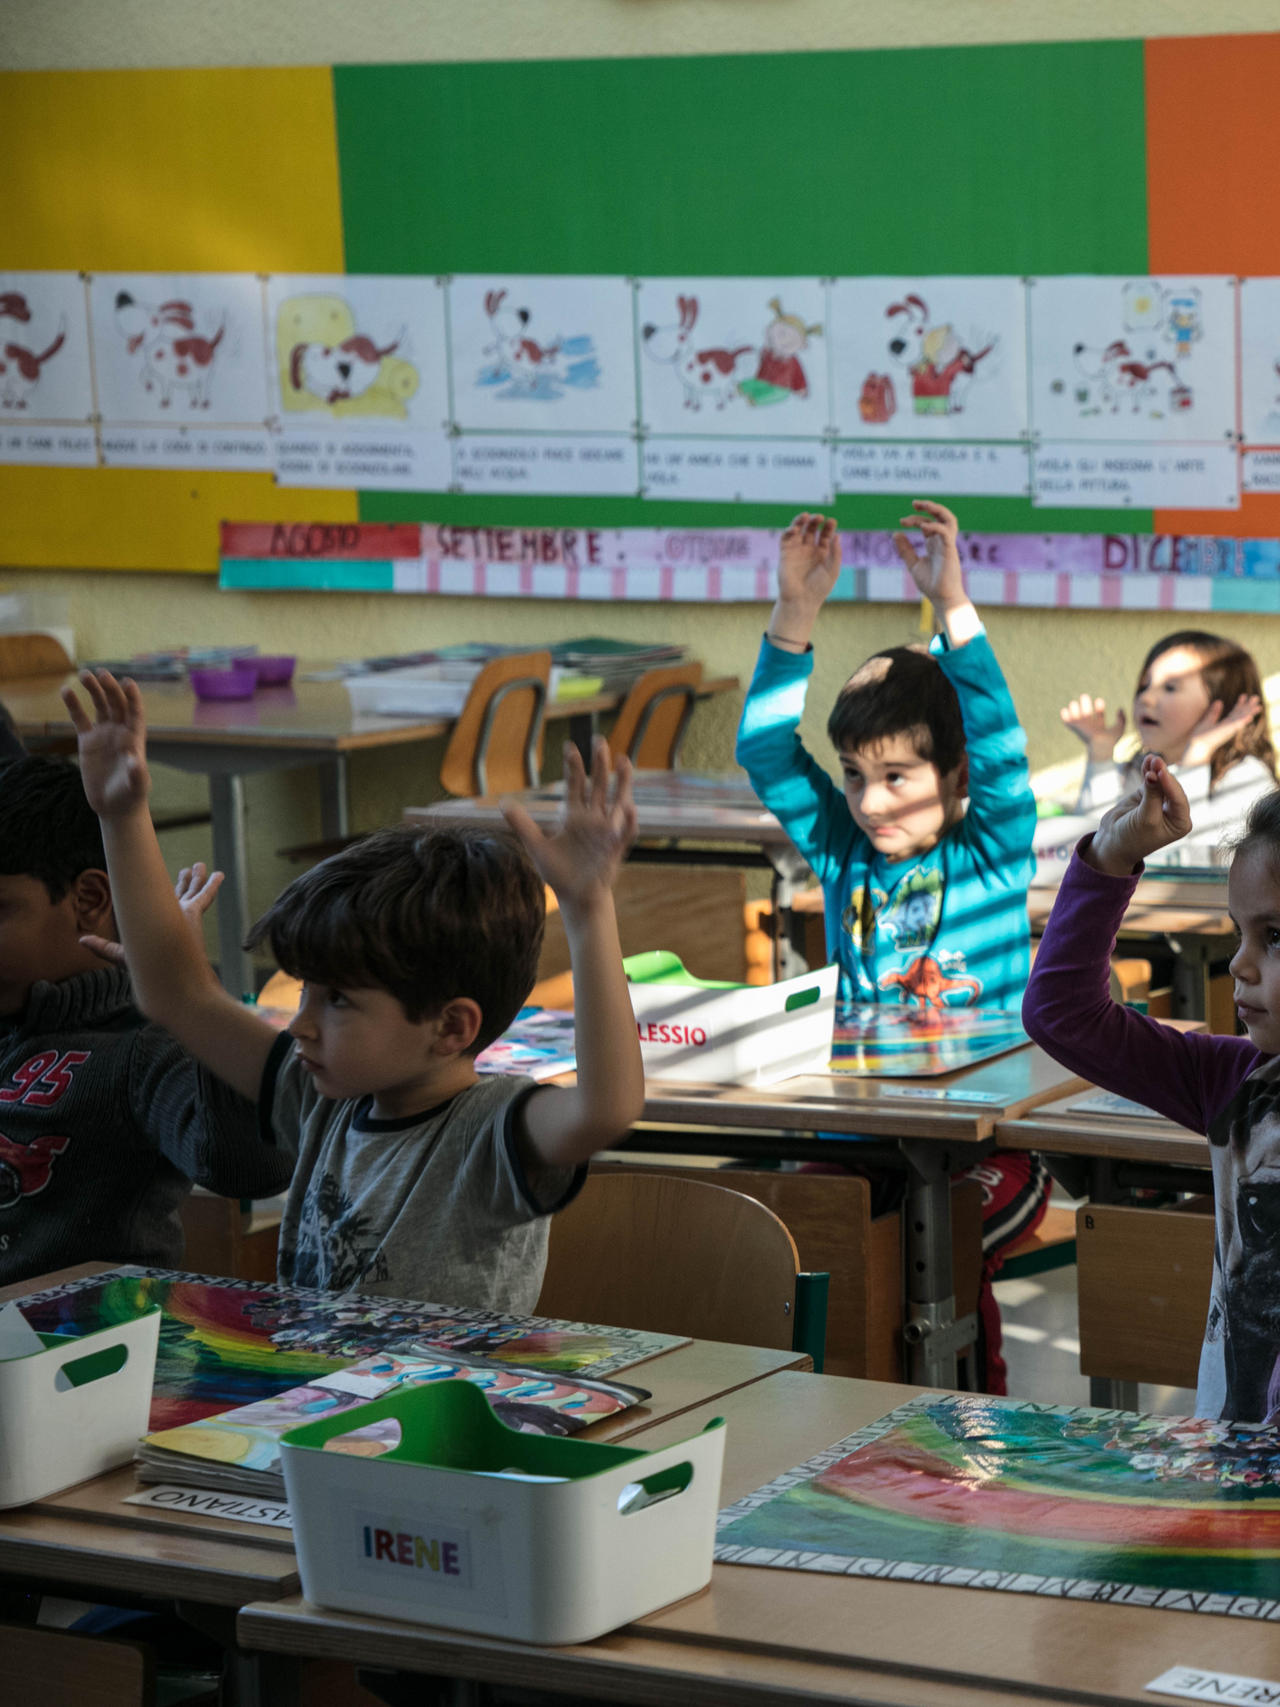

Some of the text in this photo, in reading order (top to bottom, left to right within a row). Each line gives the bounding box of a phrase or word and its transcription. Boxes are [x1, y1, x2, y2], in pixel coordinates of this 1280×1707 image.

[0, 1050, 91, 1109] 95
[151, 1490, 292, 1522] ASTIANO
[363, 1526, 460, 1576] IRENE
